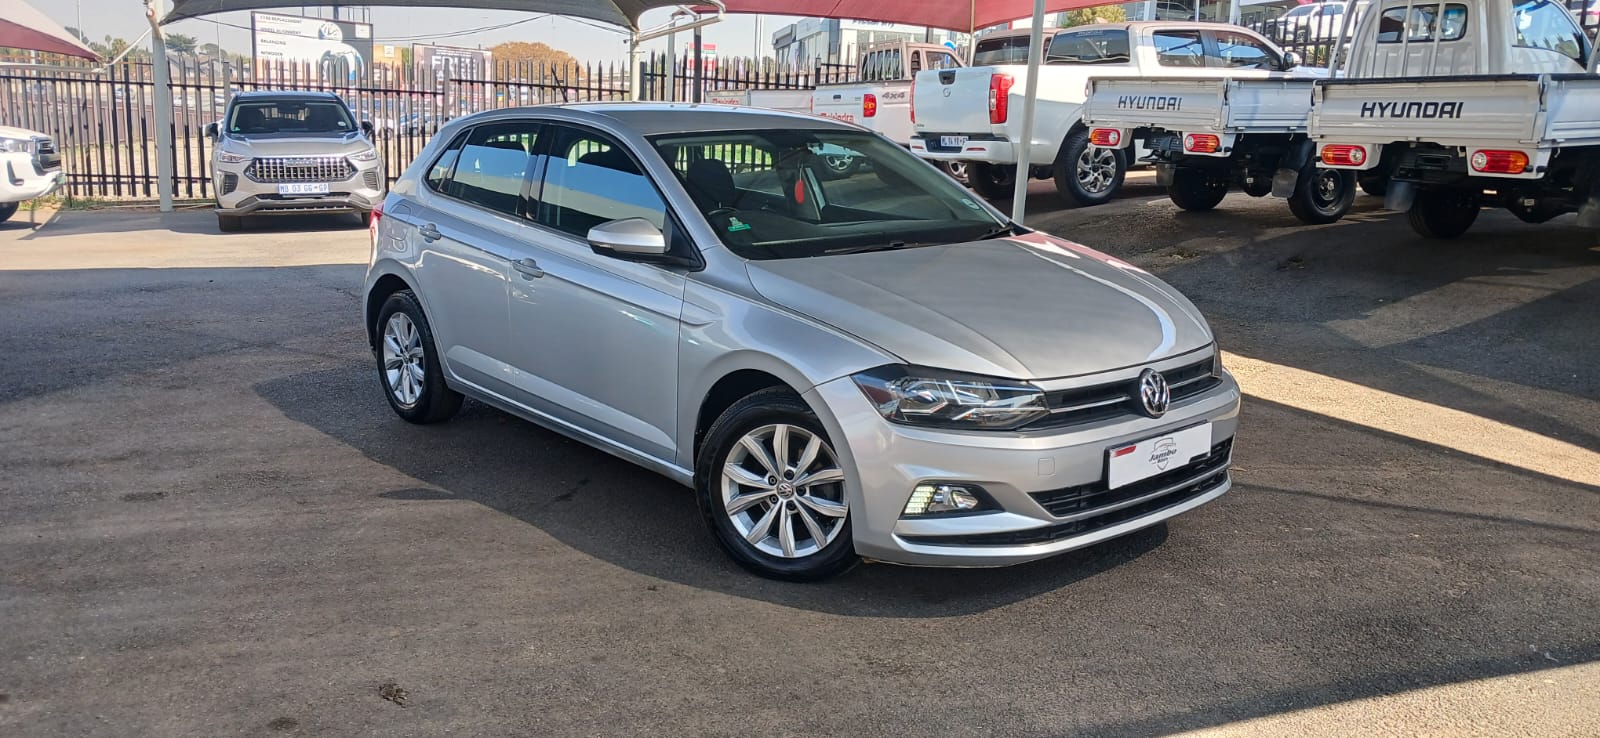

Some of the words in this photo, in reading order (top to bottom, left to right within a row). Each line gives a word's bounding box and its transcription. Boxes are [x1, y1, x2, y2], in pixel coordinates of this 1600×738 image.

[1118, 96, 1182, 111] HYUNDAI
[1360, 101, 1464, 119] HYUNDAI
[1149, 449, 1177, 462] Jambo
